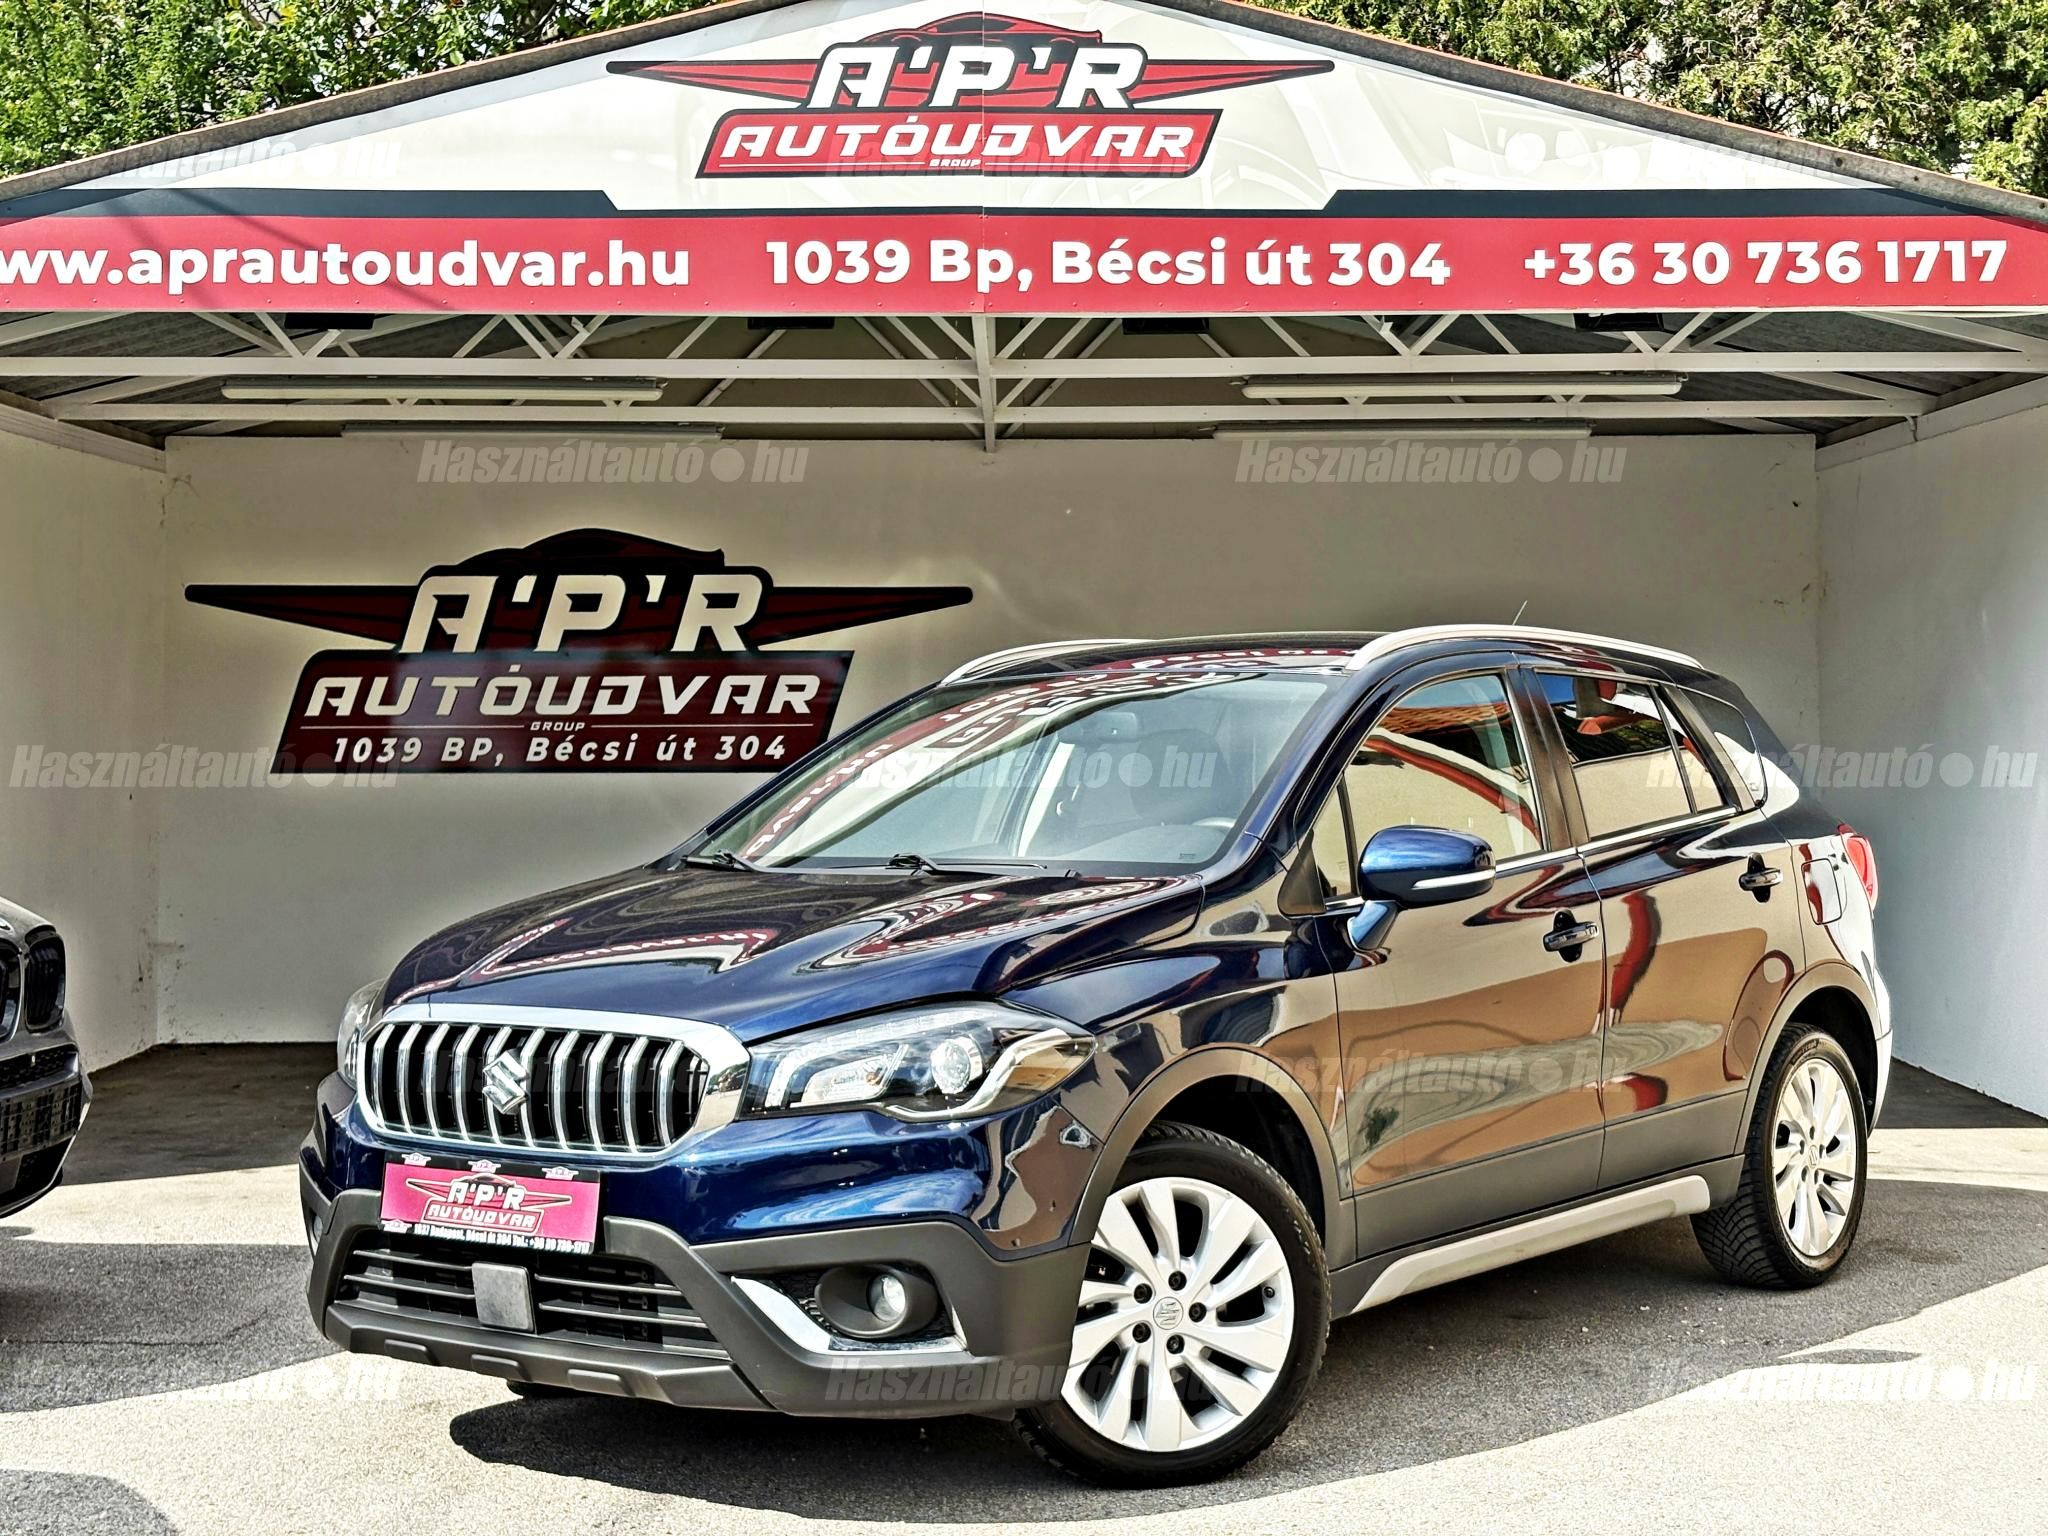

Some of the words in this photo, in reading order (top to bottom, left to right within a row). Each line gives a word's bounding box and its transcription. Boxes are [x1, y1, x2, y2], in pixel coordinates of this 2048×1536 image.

[719, 115, 1196, 158] AUTÓUDVAR
[929, 158, 982, 167] GROUP
[766, 240, 909, 285] 1039
[930, 240, 1033, 293] Bp,
[1052, 237, 1225, 285] Bécsi
[1246, 239, 1312, 286] út
[1328, 243, 1451, 286] 304
[1524, 243, 1634, 286] +36
[1653, 242, 1730, 285] 30
[1747, 241, 1862, 284] 736
[1877, 240, 2007, 283] 1717
[303, 665, 821, 717] AUTÓUDVAR
[530, 721, 586, 731] GROUP
[334, 736, 421, 763] 1039
[441, 738, 505, 768] BP,
[526, 731, 632, 763] Bécsi
[656, 734, 697, 762] út
[715, 734, 786, 761] 304
